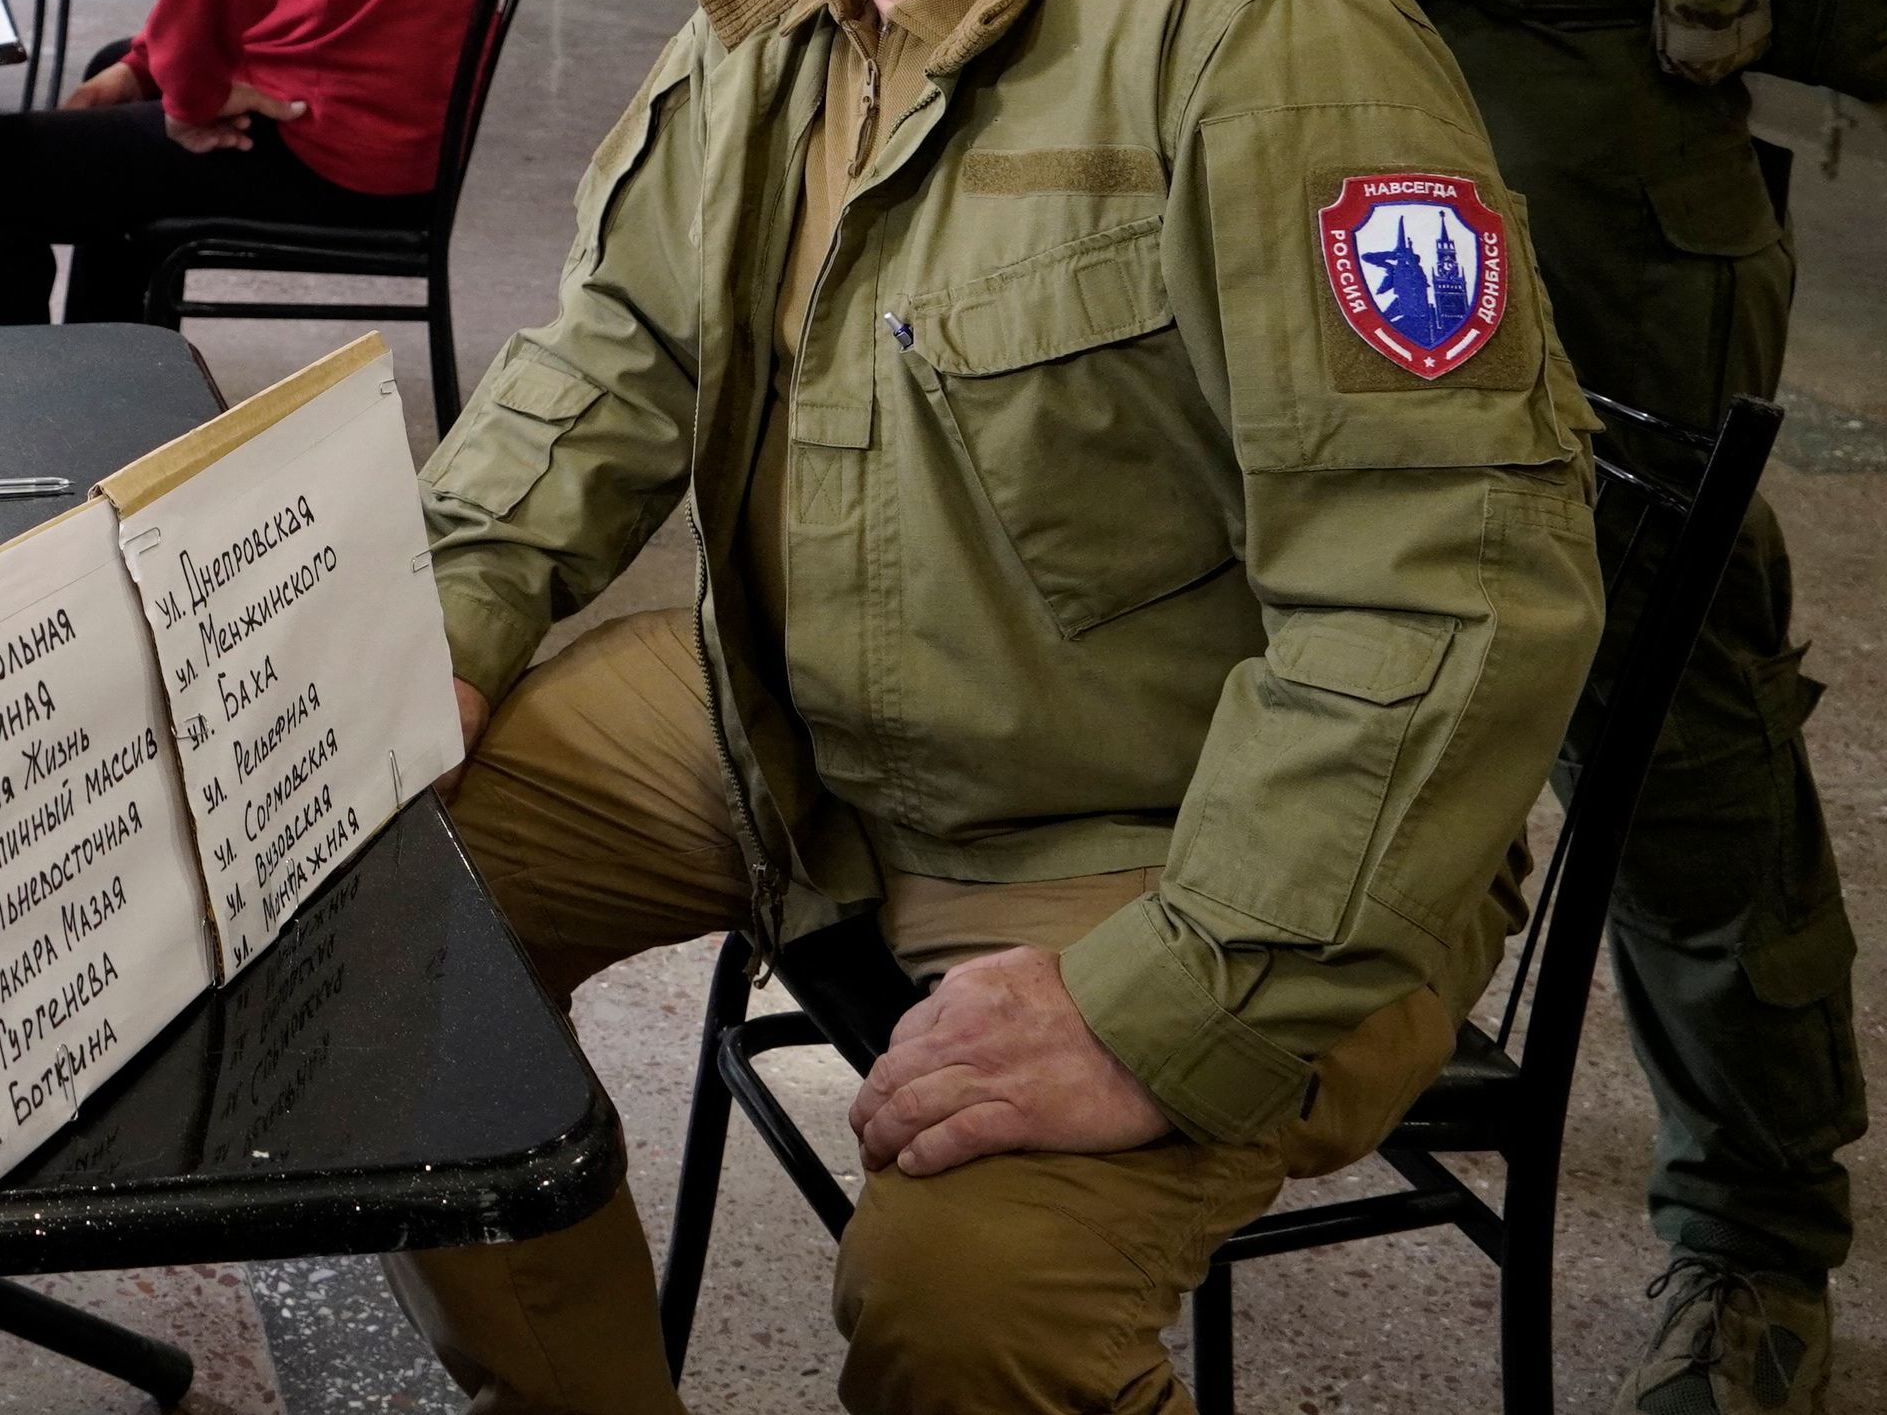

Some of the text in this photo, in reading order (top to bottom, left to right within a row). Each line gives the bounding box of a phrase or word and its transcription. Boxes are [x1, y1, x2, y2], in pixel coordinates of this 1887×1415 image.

[1363, 180, 1458, 199] НАВСЕГДА
[1330, 228, 1368, 314] РОССИЯ
[1477, 231, 1500, 326] ДОНБАСС
[155, 590, 187, 630] ул.
[175, 658, 199, 693] ул.
[203, 776, 228, 814] ул.
[214, 837, 238, 873] ул.
[226, 882, 247, 921] ул.
[233, 934, 254, 969] ул.
